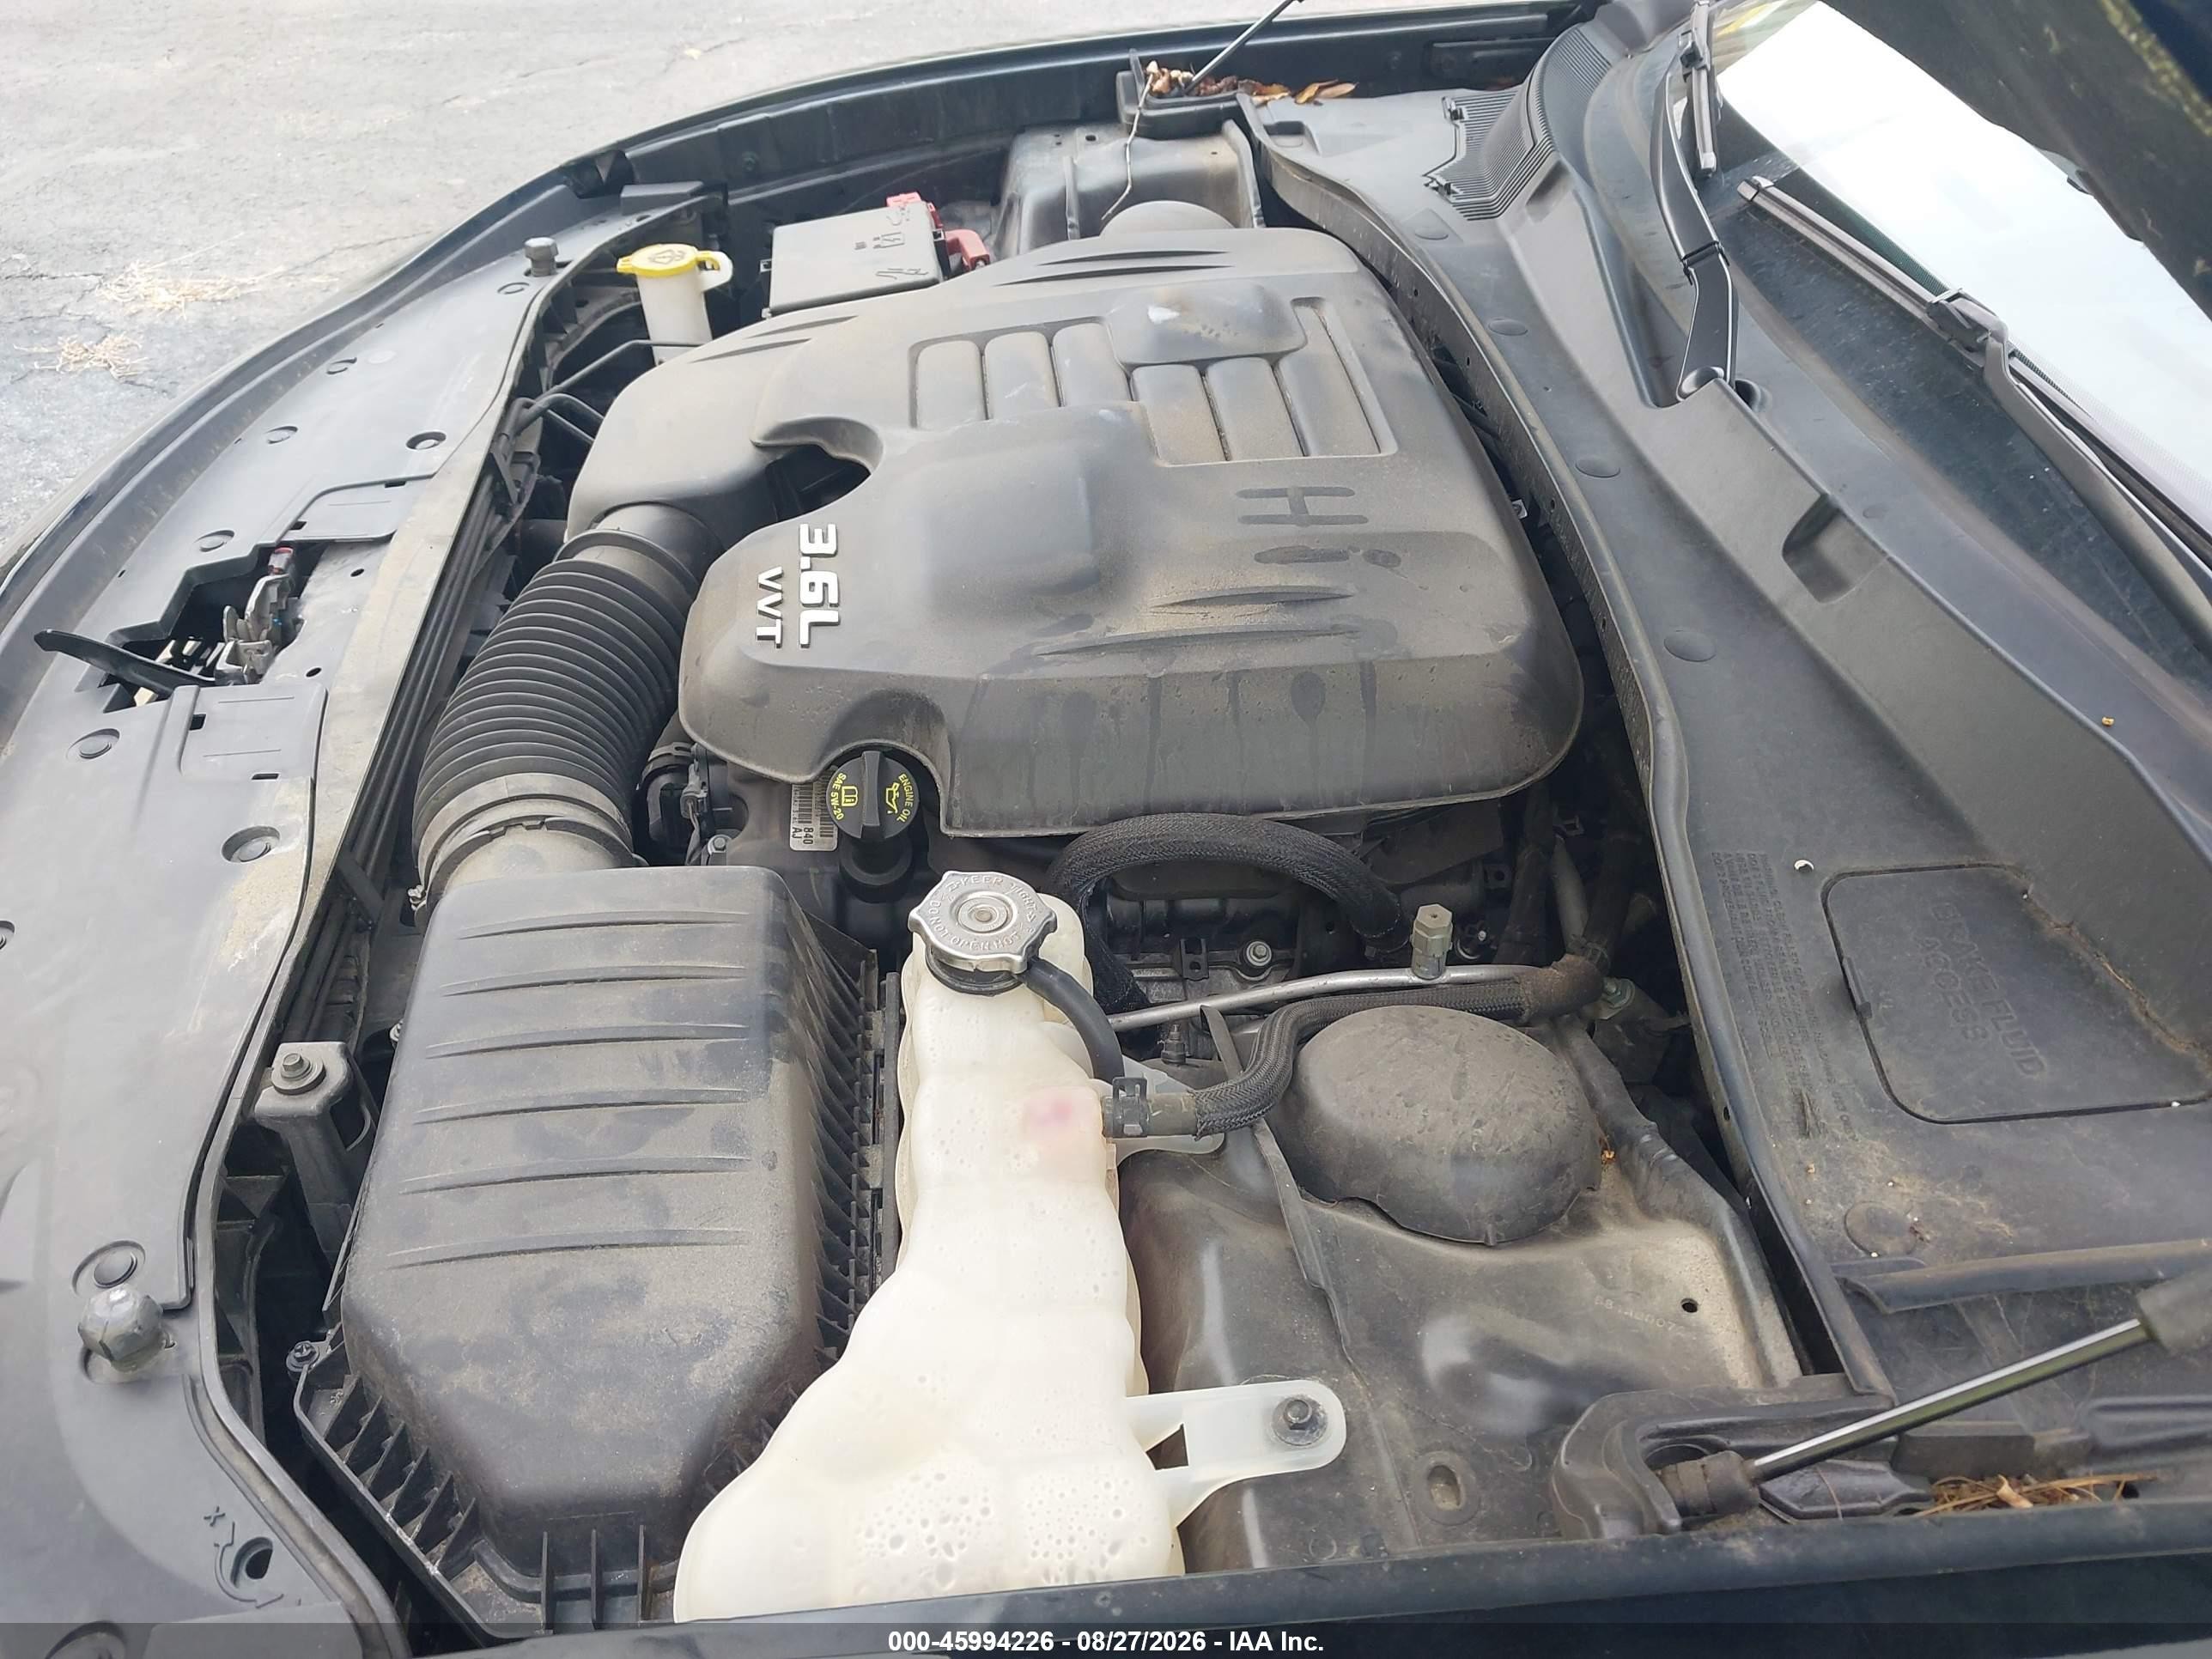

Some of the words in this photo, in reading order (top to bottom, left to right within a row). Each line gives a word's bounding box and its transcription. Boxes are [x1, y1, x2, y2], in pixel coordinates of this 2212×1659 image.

[799, 523, 840, 648] 3.6L
[756, 566, 783, 648] VVT
[832, 772, 847, 791] SAE
[897, 773, 915, 808] ENGINE
[830, 791, 845, 821] 5W-20
[896, 808, 911, 823] OIL
[793, 827, 803, 839] AJ
[803, 827, 814, 845] 840
[1980, 998, 2048, 1076] FLUID
